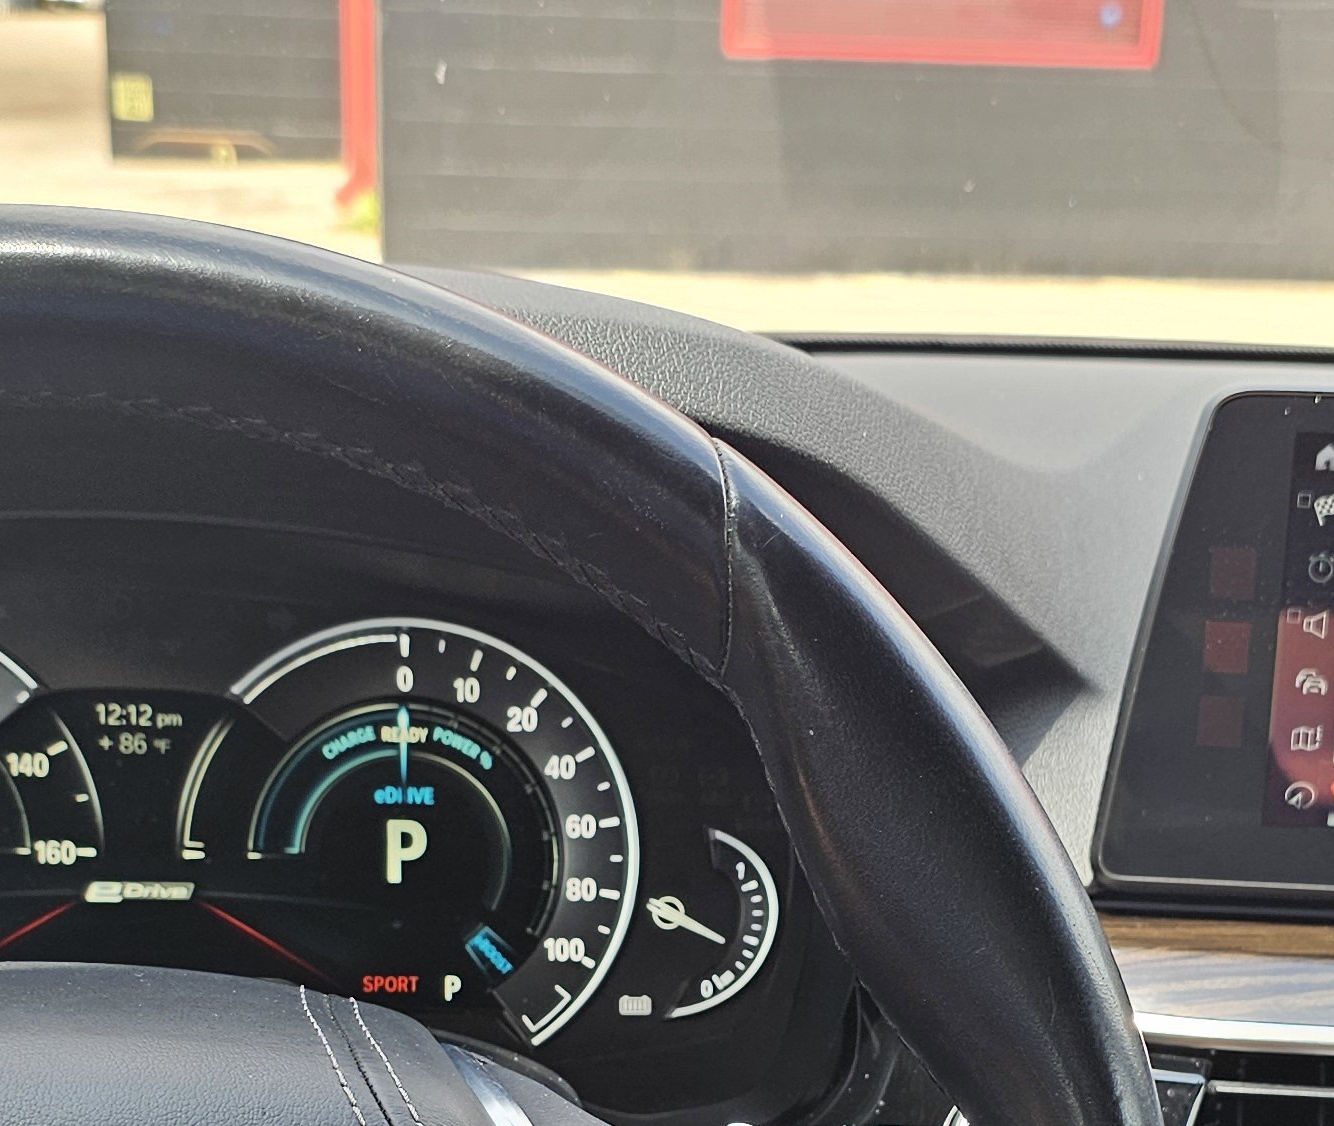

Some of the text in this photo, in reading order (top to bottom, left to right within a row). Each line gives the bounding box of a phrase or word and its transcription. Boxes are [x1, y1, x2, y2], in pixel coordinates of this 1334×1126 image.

[396, 666, 413, 693] 0
[453, 677, 480, 704] 10
[95, 702, 183, 729] 12:12 pm
[506, 705, 538, 734] 20
[118, 731, 148, 755] 86
[7, 751, 49, 778] 140
[544, 753, 576, 782] 40
[565, 812, 596, 840] 60
[34, 839, 77, 866] 160
[385, 818, 428, 884] P
[565, 877, 597, 903] 80
[544, 936, 586, 963] 100
[362, 975, 420, 993] SPORT
[443, 973, 462, 1001] P
[700, 979, 714, 999] 0
